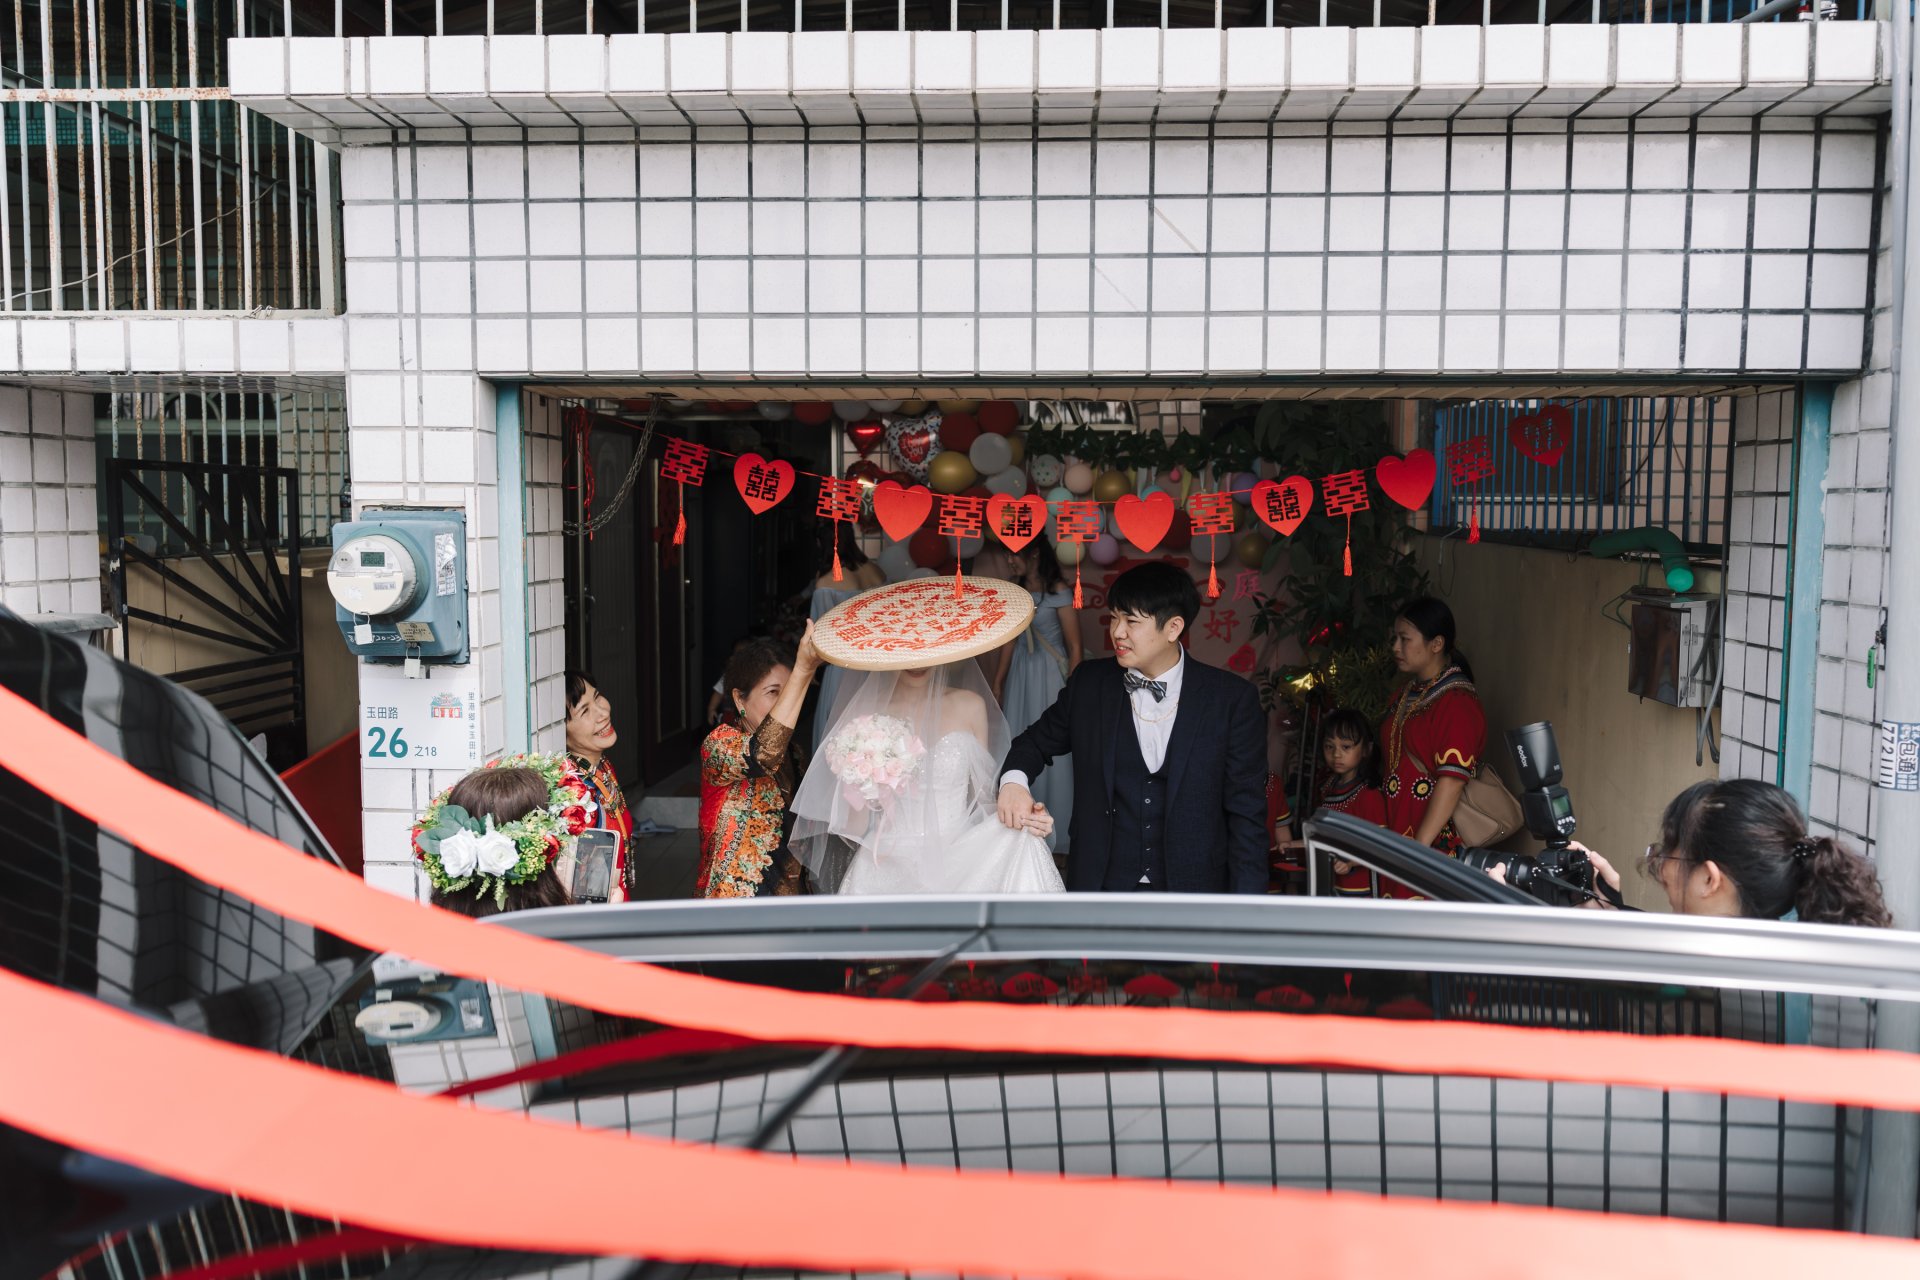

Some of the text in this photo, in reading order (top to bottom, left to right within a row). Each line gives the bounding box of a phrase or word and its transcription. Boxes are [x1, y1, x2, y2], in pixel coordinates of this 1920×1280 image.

[1203, 609, 1240, 643] 好
[366, 706, 398, 719] 玉田路
[367, 726, 438, 759] 26 之18
[1898, 740, 1918, 773] 包通
